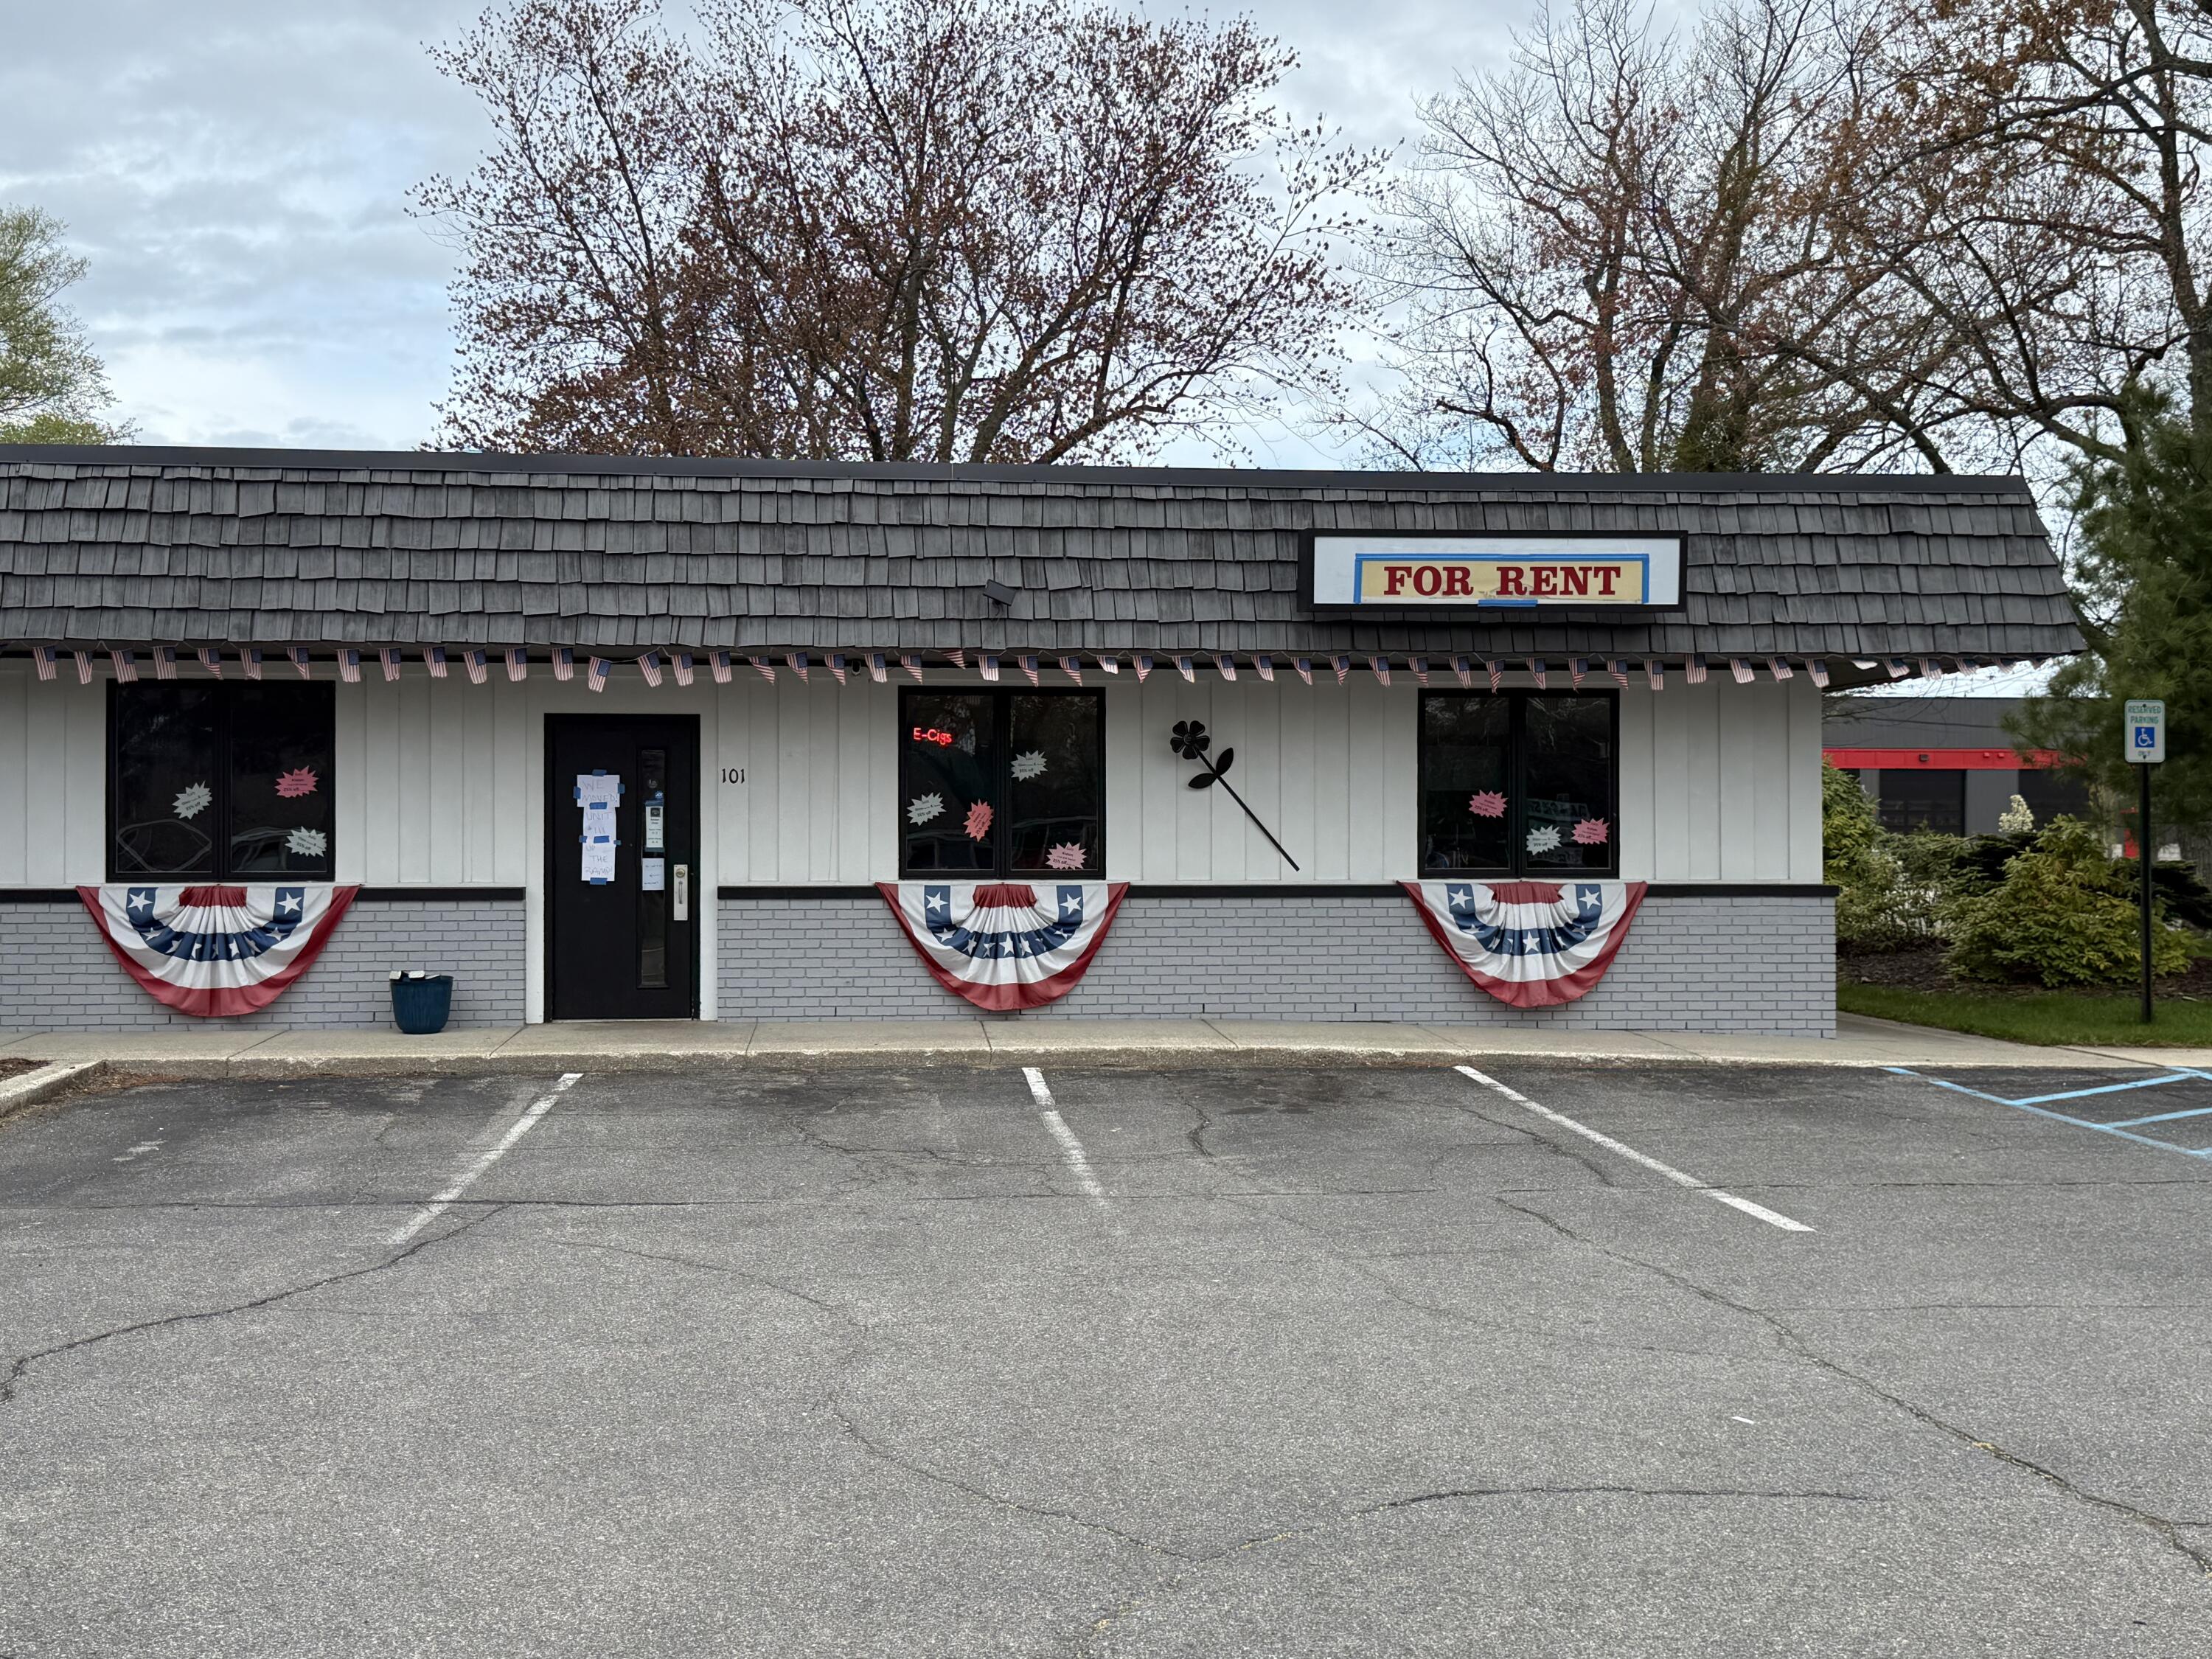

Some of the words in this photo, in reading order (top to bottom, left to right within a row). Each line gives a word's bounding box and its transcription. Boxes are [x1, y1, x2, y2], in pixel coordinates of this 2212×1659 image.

[1383, 566, 1474, 596] FOR
[1495, 566, 1621, 596] RENT
[2128, 706, 2162, 714] RESERVED
[2130, 716, 2160, 724] PARKING
[914, 727, 953, 745] E-Cigs
[722, 768, 745, 784] 101
[582, 779, 605, 791] WE
[582, 793, 618, 802] MOVED!
[585, 812, 613, 821] UNIT
[589, 855, 608, 863] THE
